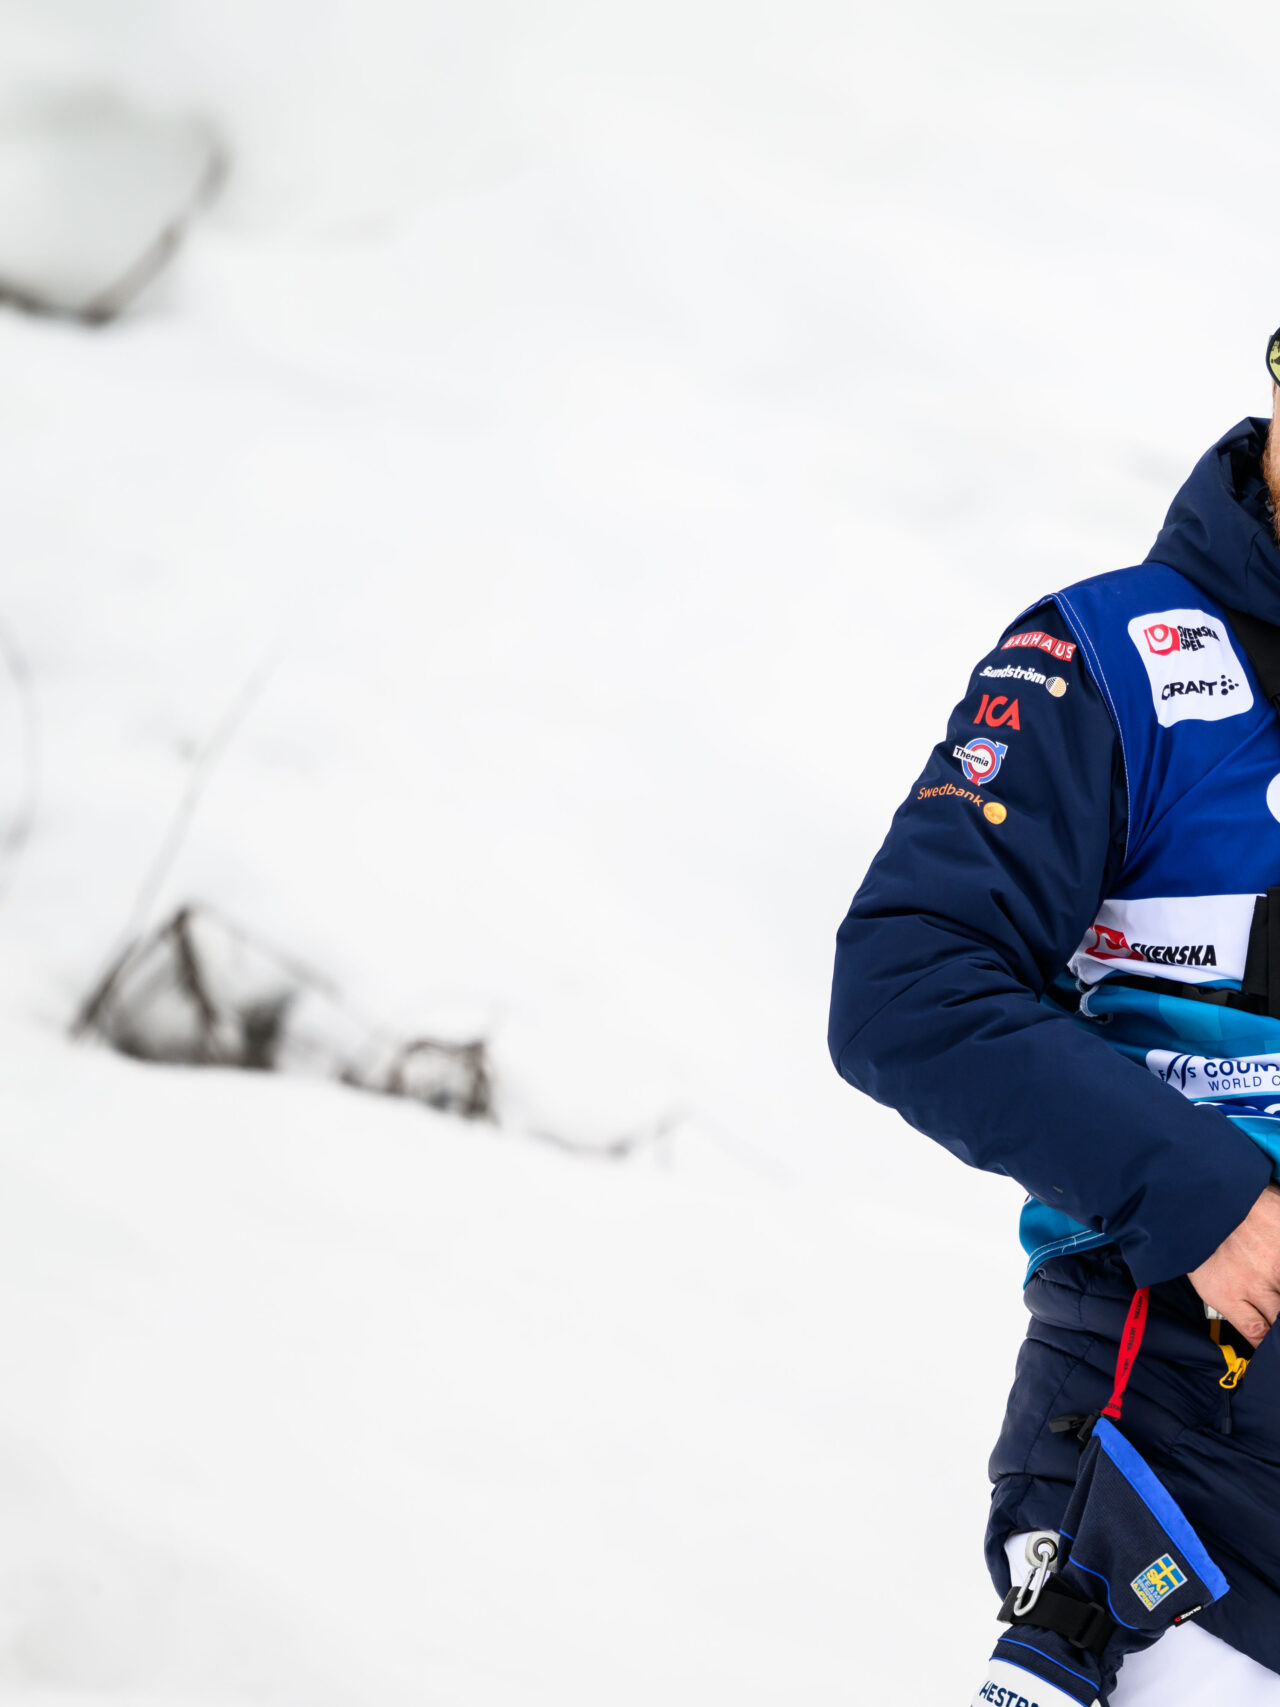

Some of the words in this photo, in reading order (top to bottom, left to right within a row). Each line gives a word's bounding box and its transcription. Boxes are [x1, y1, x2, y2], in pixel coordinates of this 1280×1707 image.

[1003, 633, 1075, 660] BAUHAUS
[1180, 638, 1206, 652] SPEL
[979, 664, 1047, 685] Sundström
[1161, 680, 1218, 701] CRAFT
[973, 694, 1021, 731] ICA
[956, 747, 990, 767] Thermia
[917, 783, 984, 807] Swedbank
[1208, 1075, 1262, 1092] WORLD
[1146, 1568, 1170, 1595] SKI
